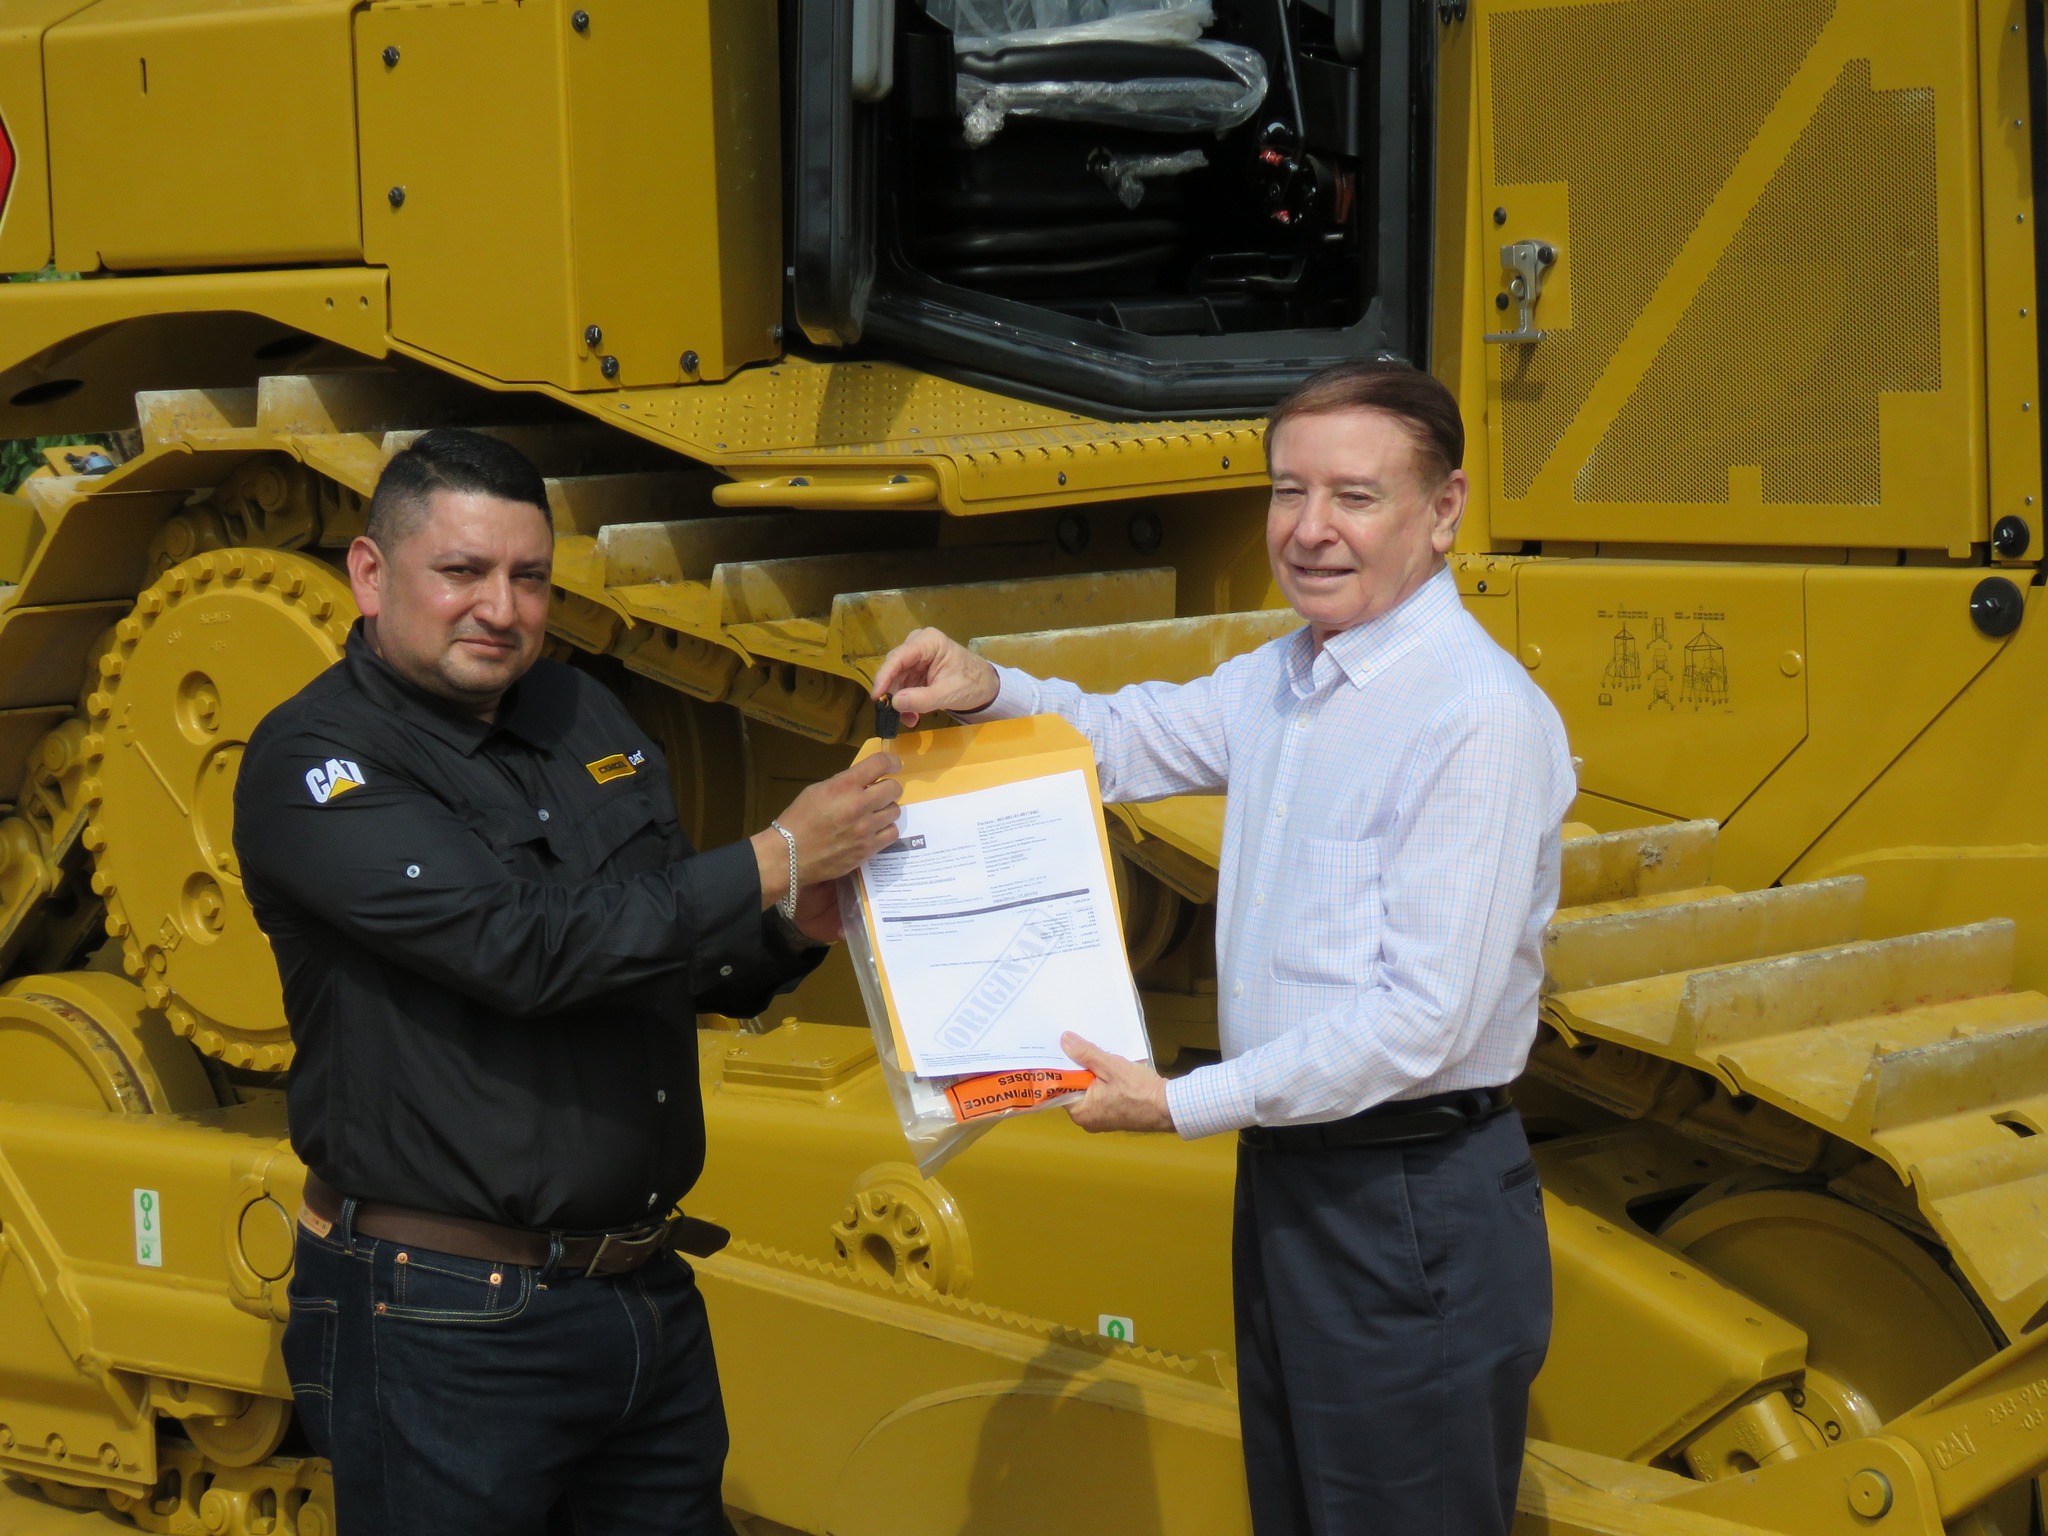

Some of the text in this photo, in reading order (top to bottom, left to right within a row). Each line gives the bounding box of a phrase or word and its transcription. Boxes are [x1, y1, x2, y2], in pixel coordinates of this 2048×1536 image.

[628, 750, 645, 766] CAT
[306, 758, 366, 803] CAT
[911, 838, 925, 847] CAT
[944, 923, 1054, 1048] ORIGINAL
[997, 1071, 1063, 1086] ENCLOSES
[1932, 1424, 1977, 1470] CAT
